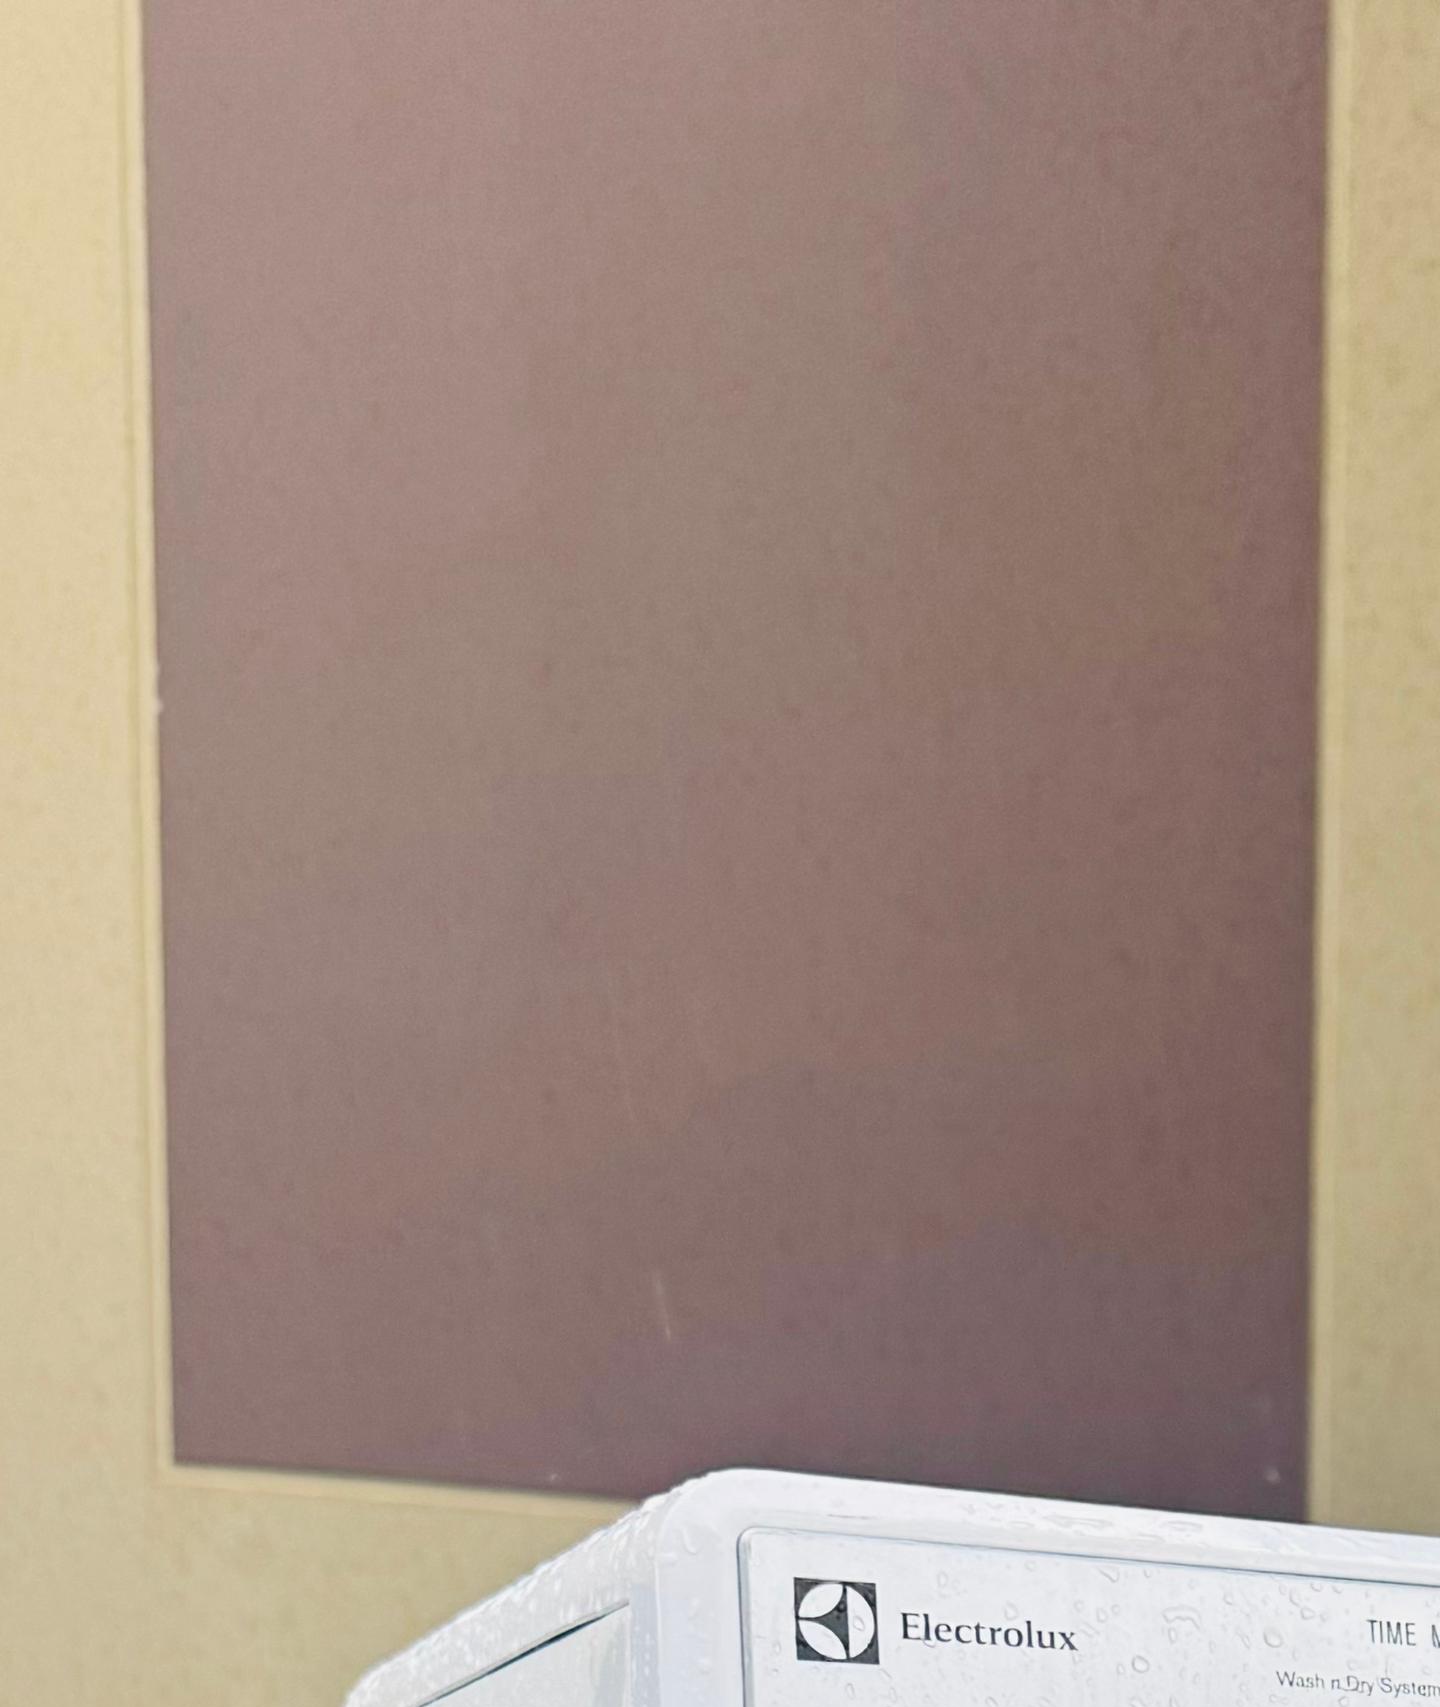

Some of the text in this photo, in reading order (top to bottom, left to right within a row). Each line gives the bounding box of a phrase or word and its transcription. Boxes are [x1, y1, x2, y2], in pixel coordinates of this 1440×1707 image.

[901, 1612, 1078, 1651] Electrolux
[1366, 1619, 1416, 1647] TIME
[1276, 1670, 1325, 1690] Wash
[1346, 1675, 1374, 1697] Dry
